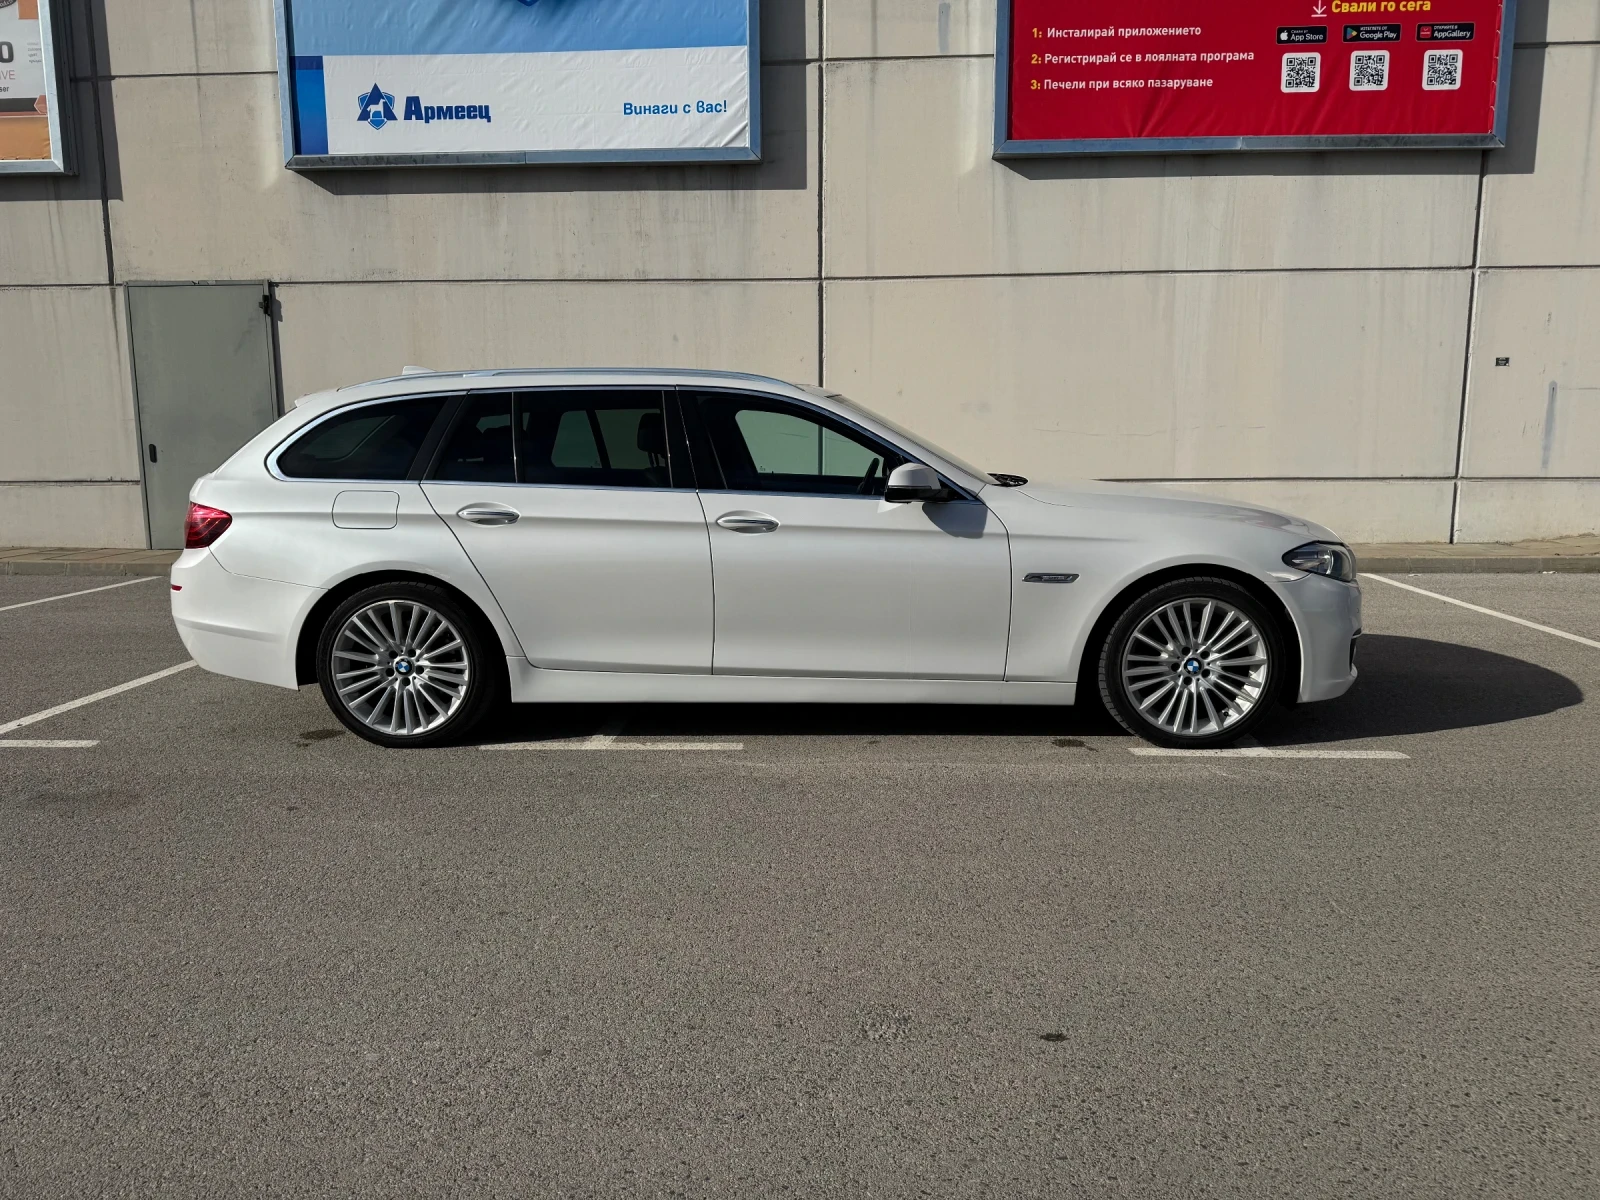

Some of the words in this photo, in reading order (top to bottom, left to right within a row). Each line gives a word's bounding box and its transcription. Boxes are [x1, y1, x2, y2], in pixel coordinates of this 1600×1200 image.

[1331, 0, 1377, 13] Свали
[1380, 1, 1396, 12] го
[1399, 0, 1432, 11] сега
[1032, 27, 1043, 39] 1:
[1047, 26, 1115, 40] Инсталирай
[1118, 26, 1202, 39] приложението
[1290, 33, 1305, 42] App
[1305, 33, 1324, 41] Store
[1359, 31, 1383, 40] Google
[1383, 30, 1398, 39] Play
[1433, 30, 1471, 39] AppGallery
[1031, 53, 1042, 65] 2:
[1044, 51, 1117, 66] Регистрирай
[1119, 53, 1133, 63] се
[1135, 53, 1142, 62] в
[1144, 52, 1197, 62] лоялната
[1200, 51, 1255, 63] програма
[1030, 79, 1041, 90] 3:
[1044, 79, 1086, 90] Печели
[1088, 80, 1110, 91] при
[1112, 79, 1145, 89] всяко
[1147, 78, 1213, 90] пазаруване
[403, 96, 492, 124] Армеец
[623, 102, 678, 116] Винаги
[682, 103, 692, 114] с
[696, 99, 727, 114] вас!
